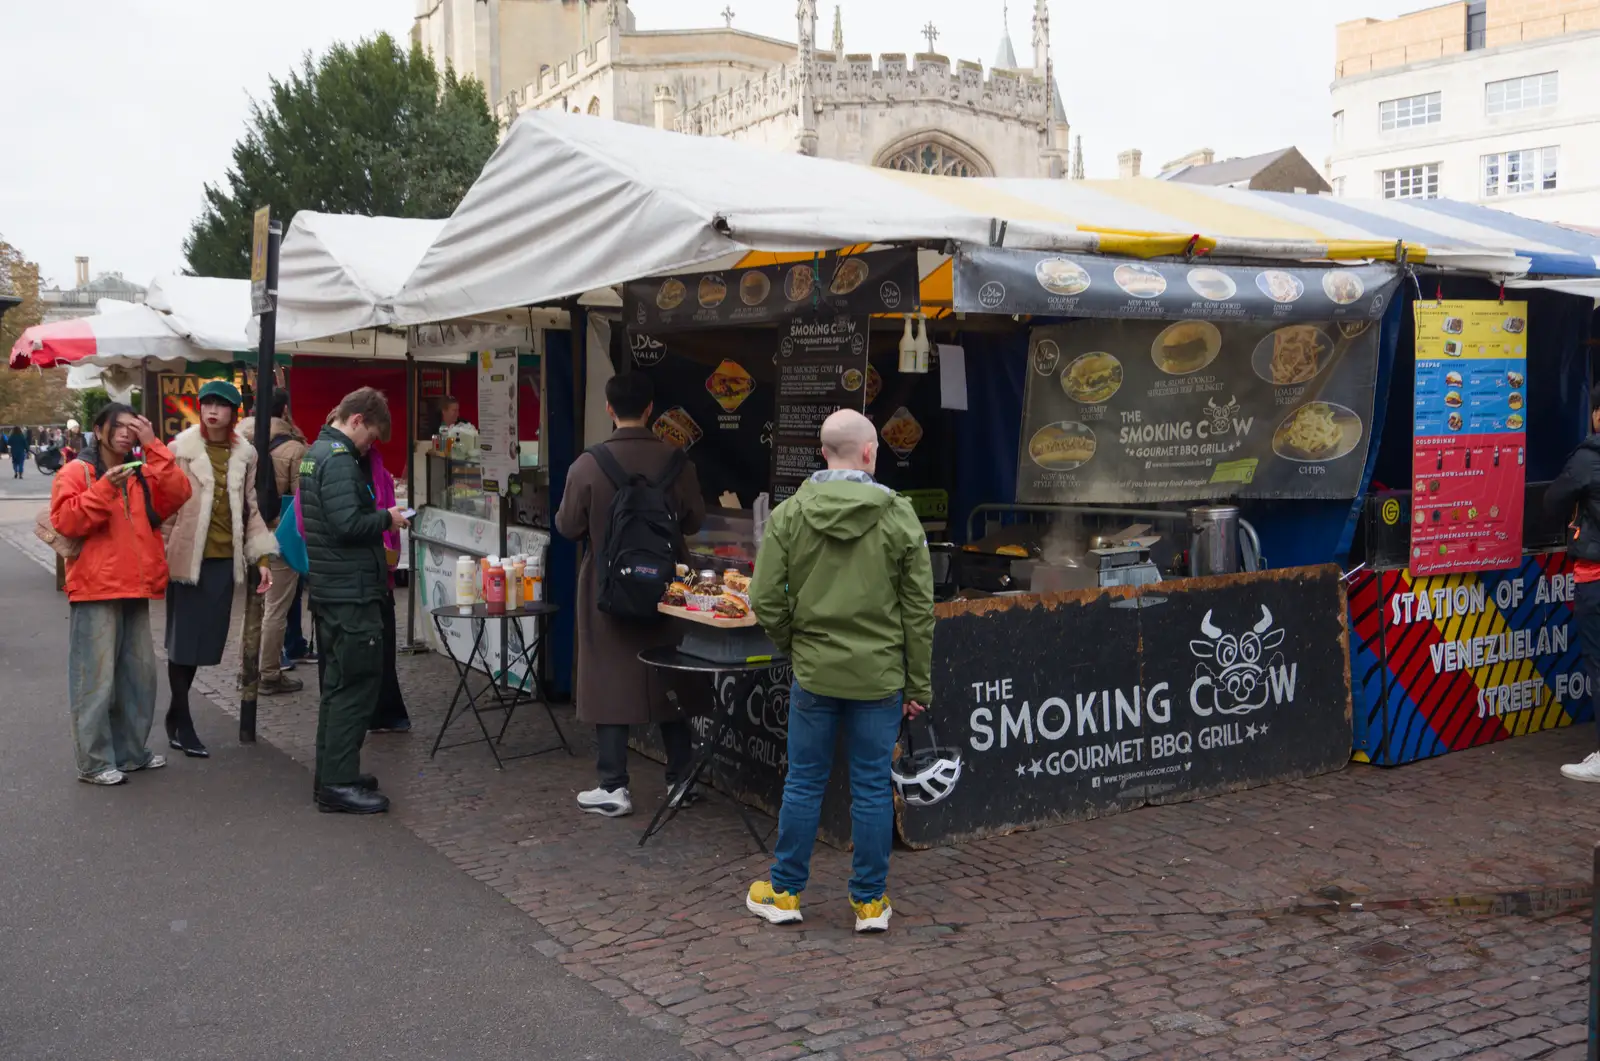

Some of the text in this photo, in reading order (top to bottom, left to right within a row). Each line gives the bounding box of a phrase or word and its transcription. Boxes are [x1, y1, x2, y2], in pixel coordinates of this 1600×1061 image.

[790, 323, 829, 336] SMOKING
[634, 351, 659, 360] HALAL
[1187, 376, 1216, 384] COOKED
[1274, 387, 1305, 397] LOADED
[1120, 410, 1142, 424] THE
[1119, 420, 1193, 444] SMOKING
[1136, 442, 1227, 458] GOURMET BBQ GRILL
[1298, 466, 1326, 476] CHIPS
[1158, 480, 1168, 488] any
[1169, 478, 1183, 488] food
[1454, 558, 1480, 567] homemade
[1480, 558, 1496, 566] street
[1392, 572, 1575, 626] STATION OF ARE
[1429, 624, 1568, 674] VENEZUELAN
[972, 678, 1014, 703] THE
[1477, 677, 1544, 718] STREET
[970, 682, 1171, 752] SMOKING
[748, 736, 777, 768] GRILL
[1045, 722, 1243, 776] GOURMET BBQ GRILL
